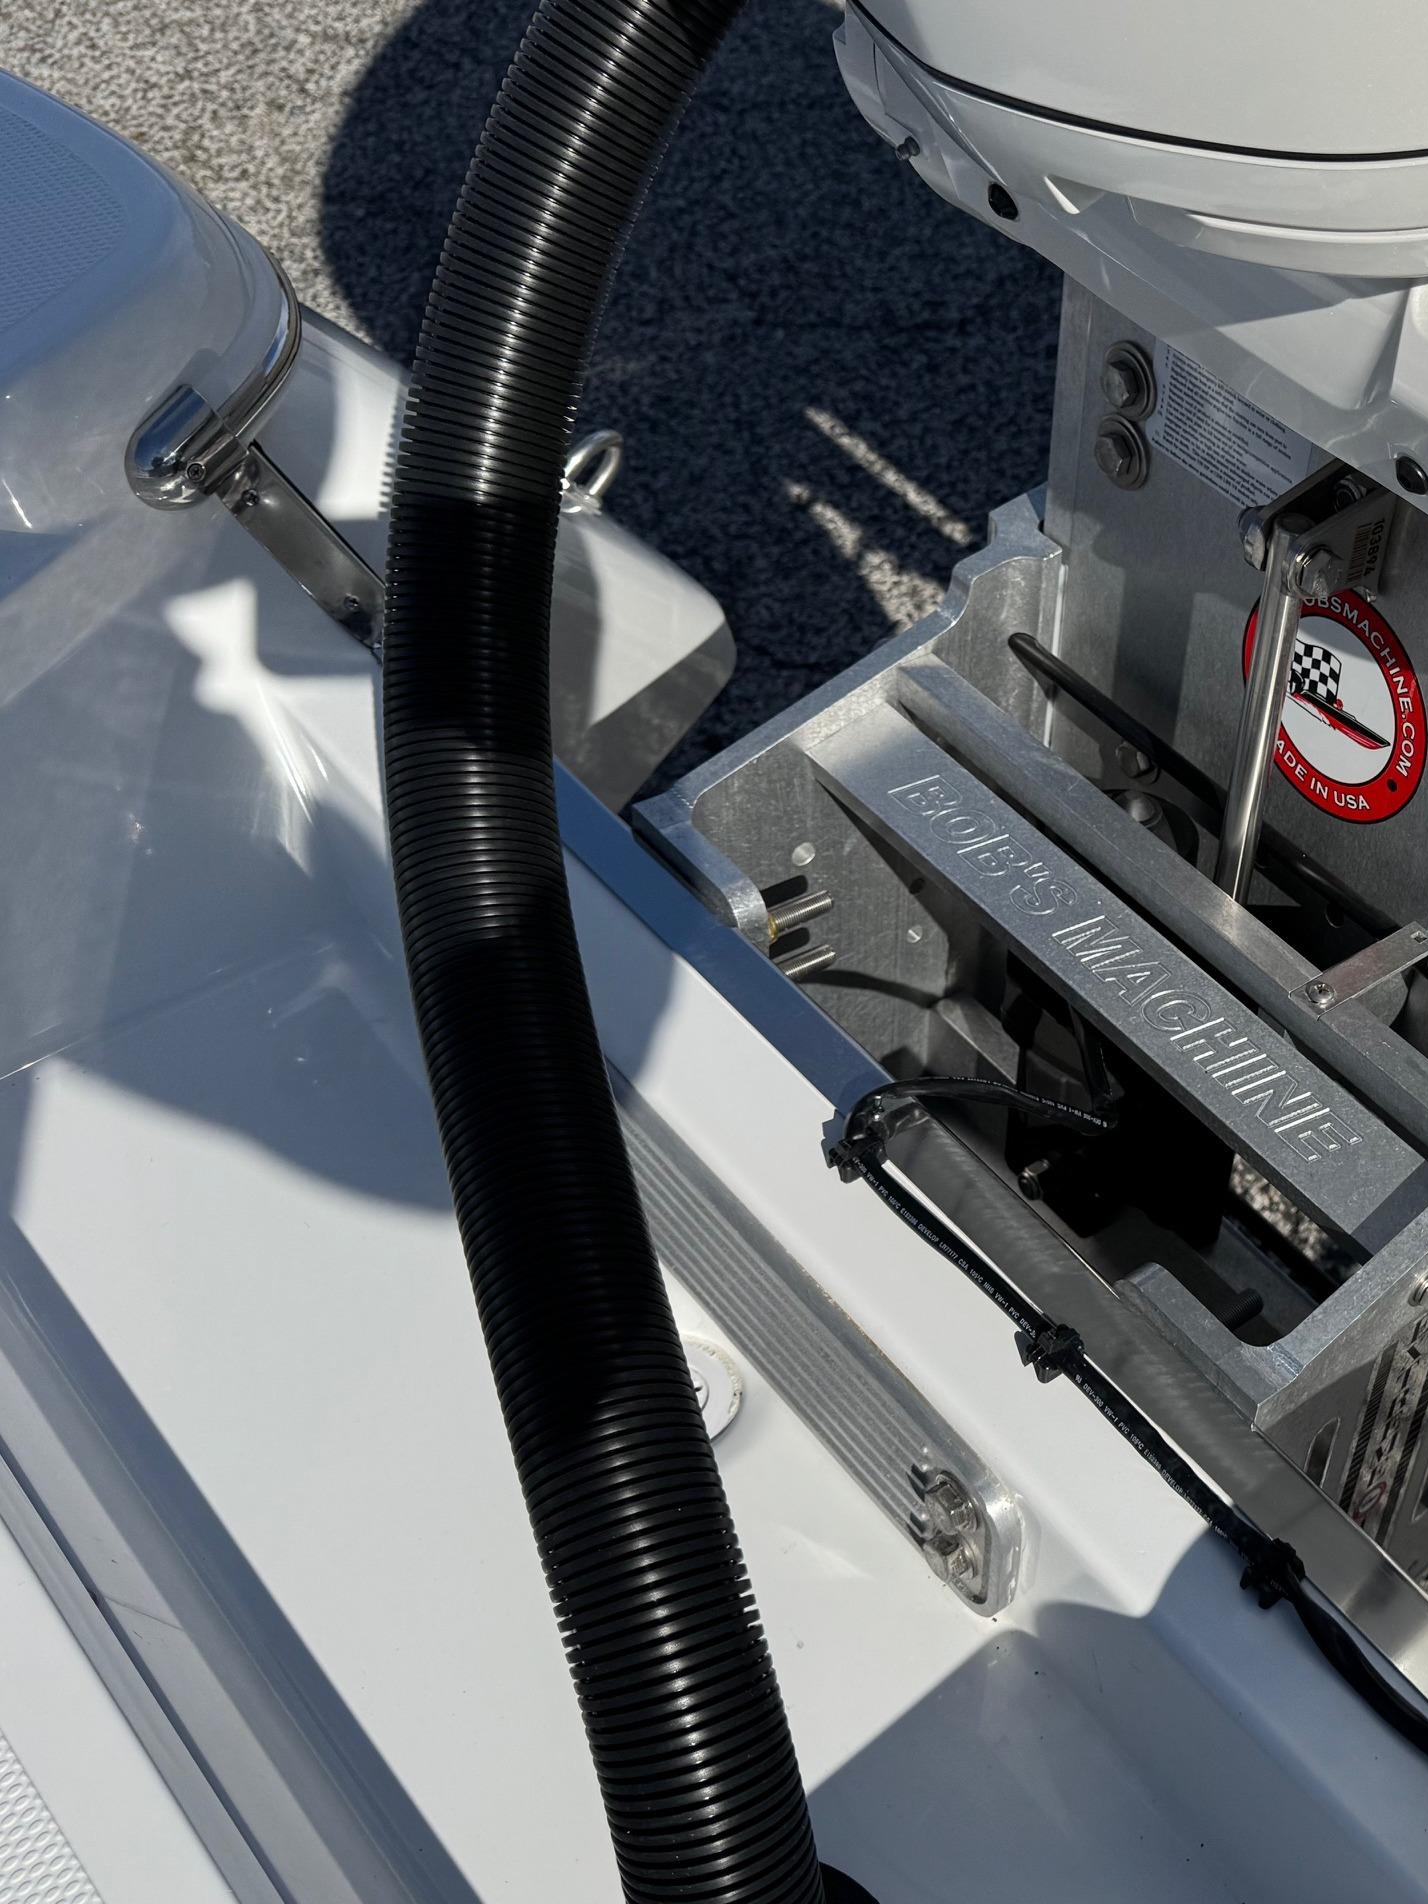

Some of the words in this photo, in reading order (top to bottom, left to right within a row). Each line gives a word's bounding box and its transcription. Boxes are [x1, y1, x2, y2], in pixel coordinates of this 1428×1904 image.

[1275, 740, 1307, 781] ADE
[1310, 777, 1328, 800] IN
[1333, 790, 1370, 810] USA
[1303, 593, 1415, 777] OBSMACHINE.COM
[888, 774, 1077, 916] BOB'S
[1052, 914, 1364, 1164] MACHINE
